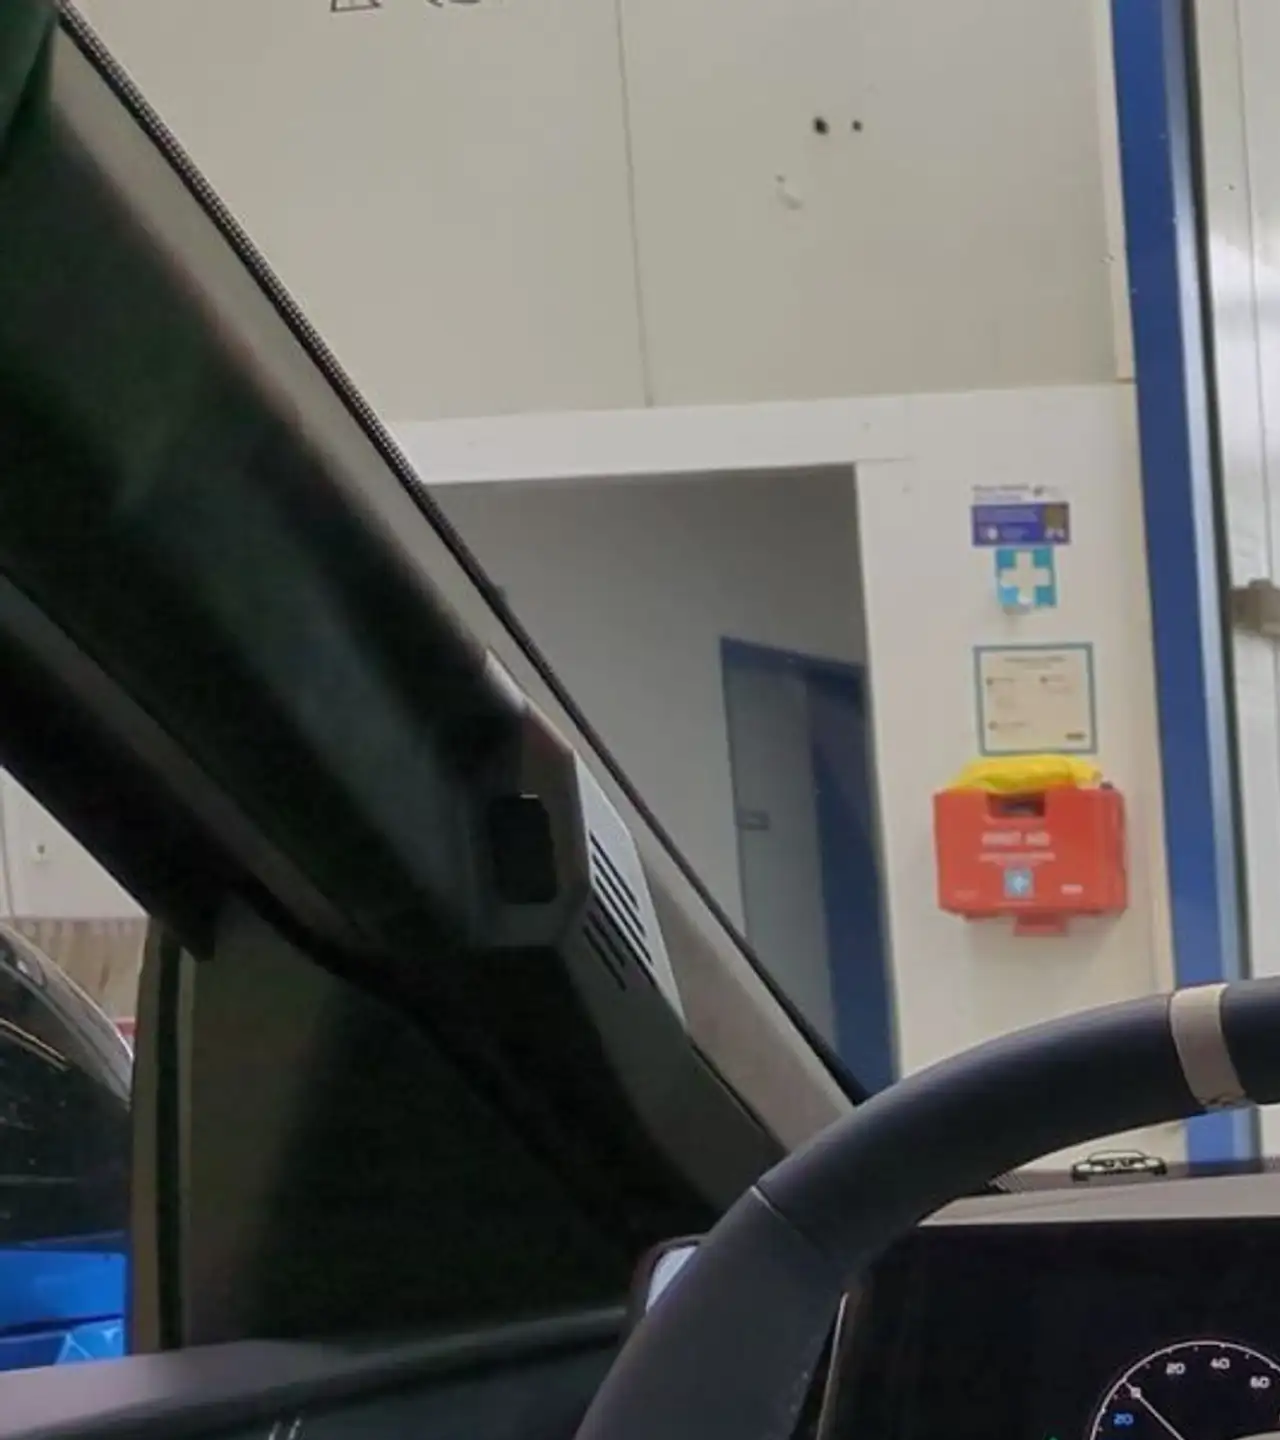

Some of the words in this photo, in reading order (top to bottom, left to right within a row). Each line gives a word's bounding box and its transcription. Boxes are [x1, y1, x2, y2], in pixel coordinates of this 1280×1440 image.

[1165, 1362, 1186, 1375] 20
[1210, 1357, 1231, 1370] 40
[1250, 1376, 1270, 1389] 60
